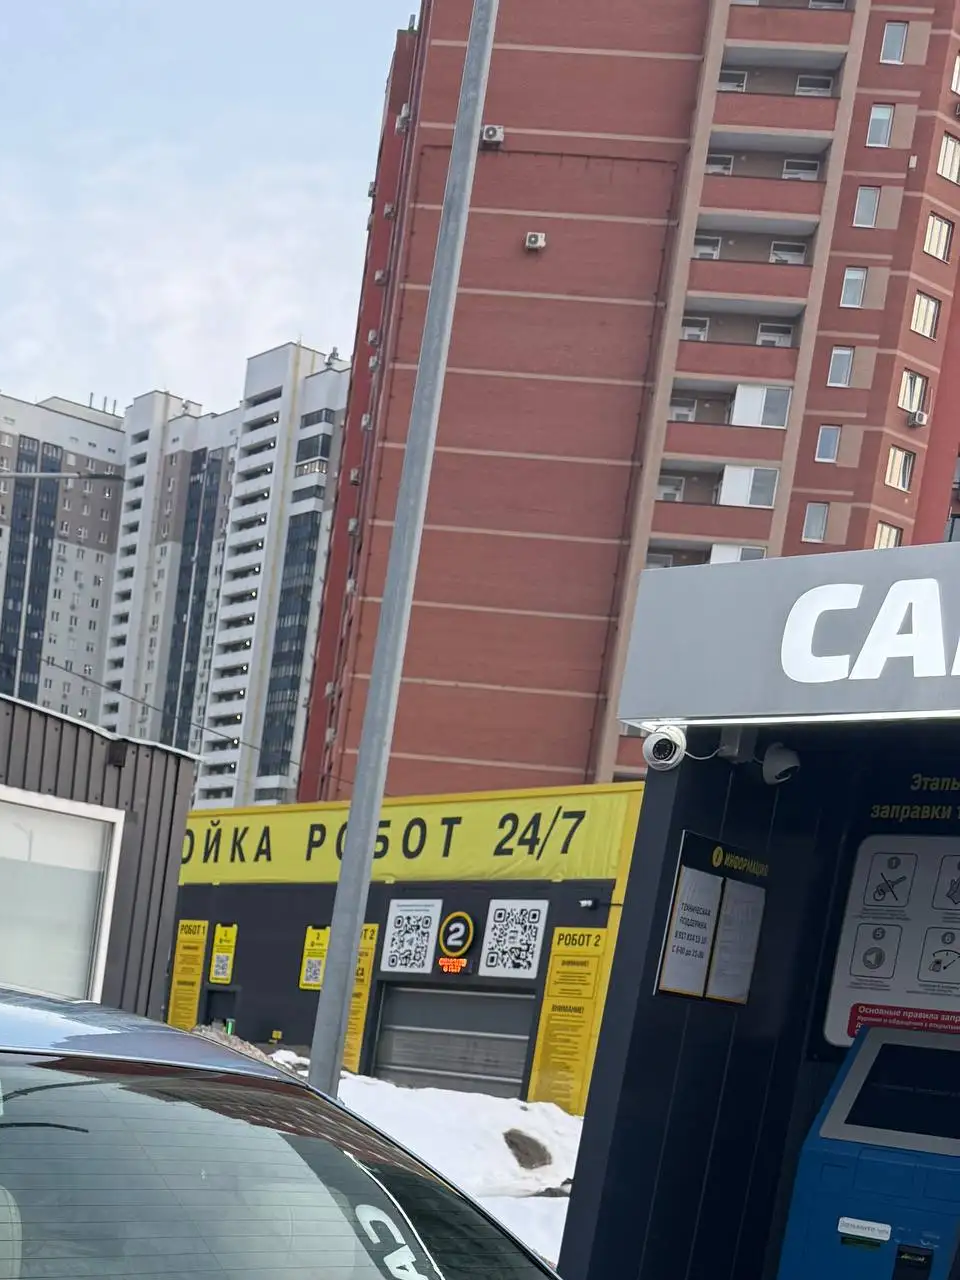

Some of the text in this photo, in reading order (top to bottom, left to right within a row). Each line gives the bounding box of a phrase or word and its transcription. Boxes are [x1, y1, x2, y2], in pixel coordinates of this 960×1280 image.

[870, 802, 953, 824] заправки
[493, 805, 587, 861] 24/7
[180, 924, 206, 935] РОБОТ 1
[447, 922, 466, 947] 2
[557, 933, 601, 947] РОБОТ 2
[858, 1005, 901, 1017] Основные
[902, 1010, 939, 1020] правила
